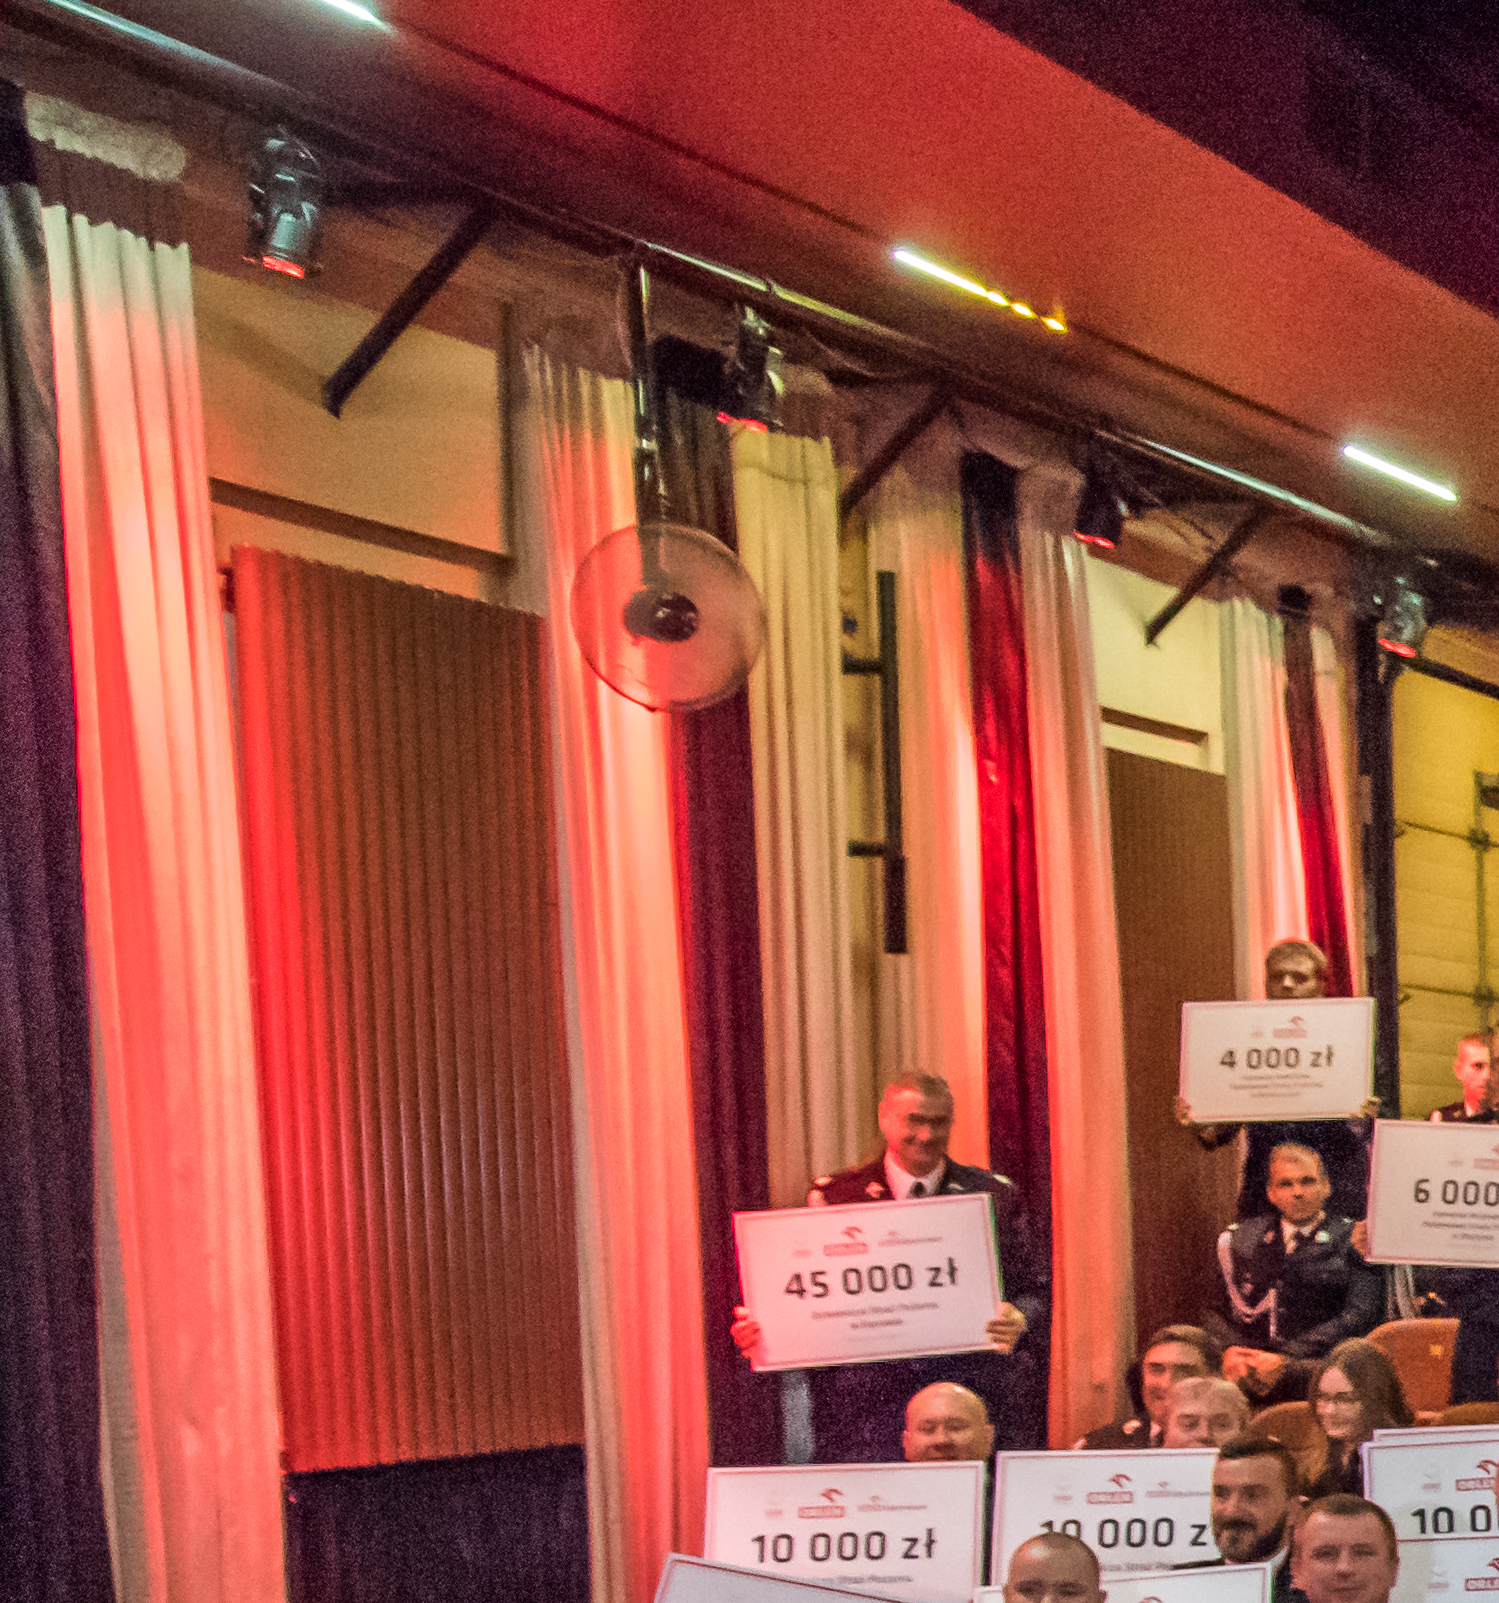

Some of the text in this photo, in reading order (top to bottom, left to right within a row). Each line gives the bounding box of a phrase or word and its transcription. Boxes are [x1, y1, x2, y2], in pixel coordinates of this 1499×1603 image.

[1219, 1045, 1334, 1070] 4 000 zł
[1414, 1179, 1430, 1203] 6
[785, 1257, 958, 1299] 45 000 zł
[752, 1528, 936, 1563] 10 000 zł
